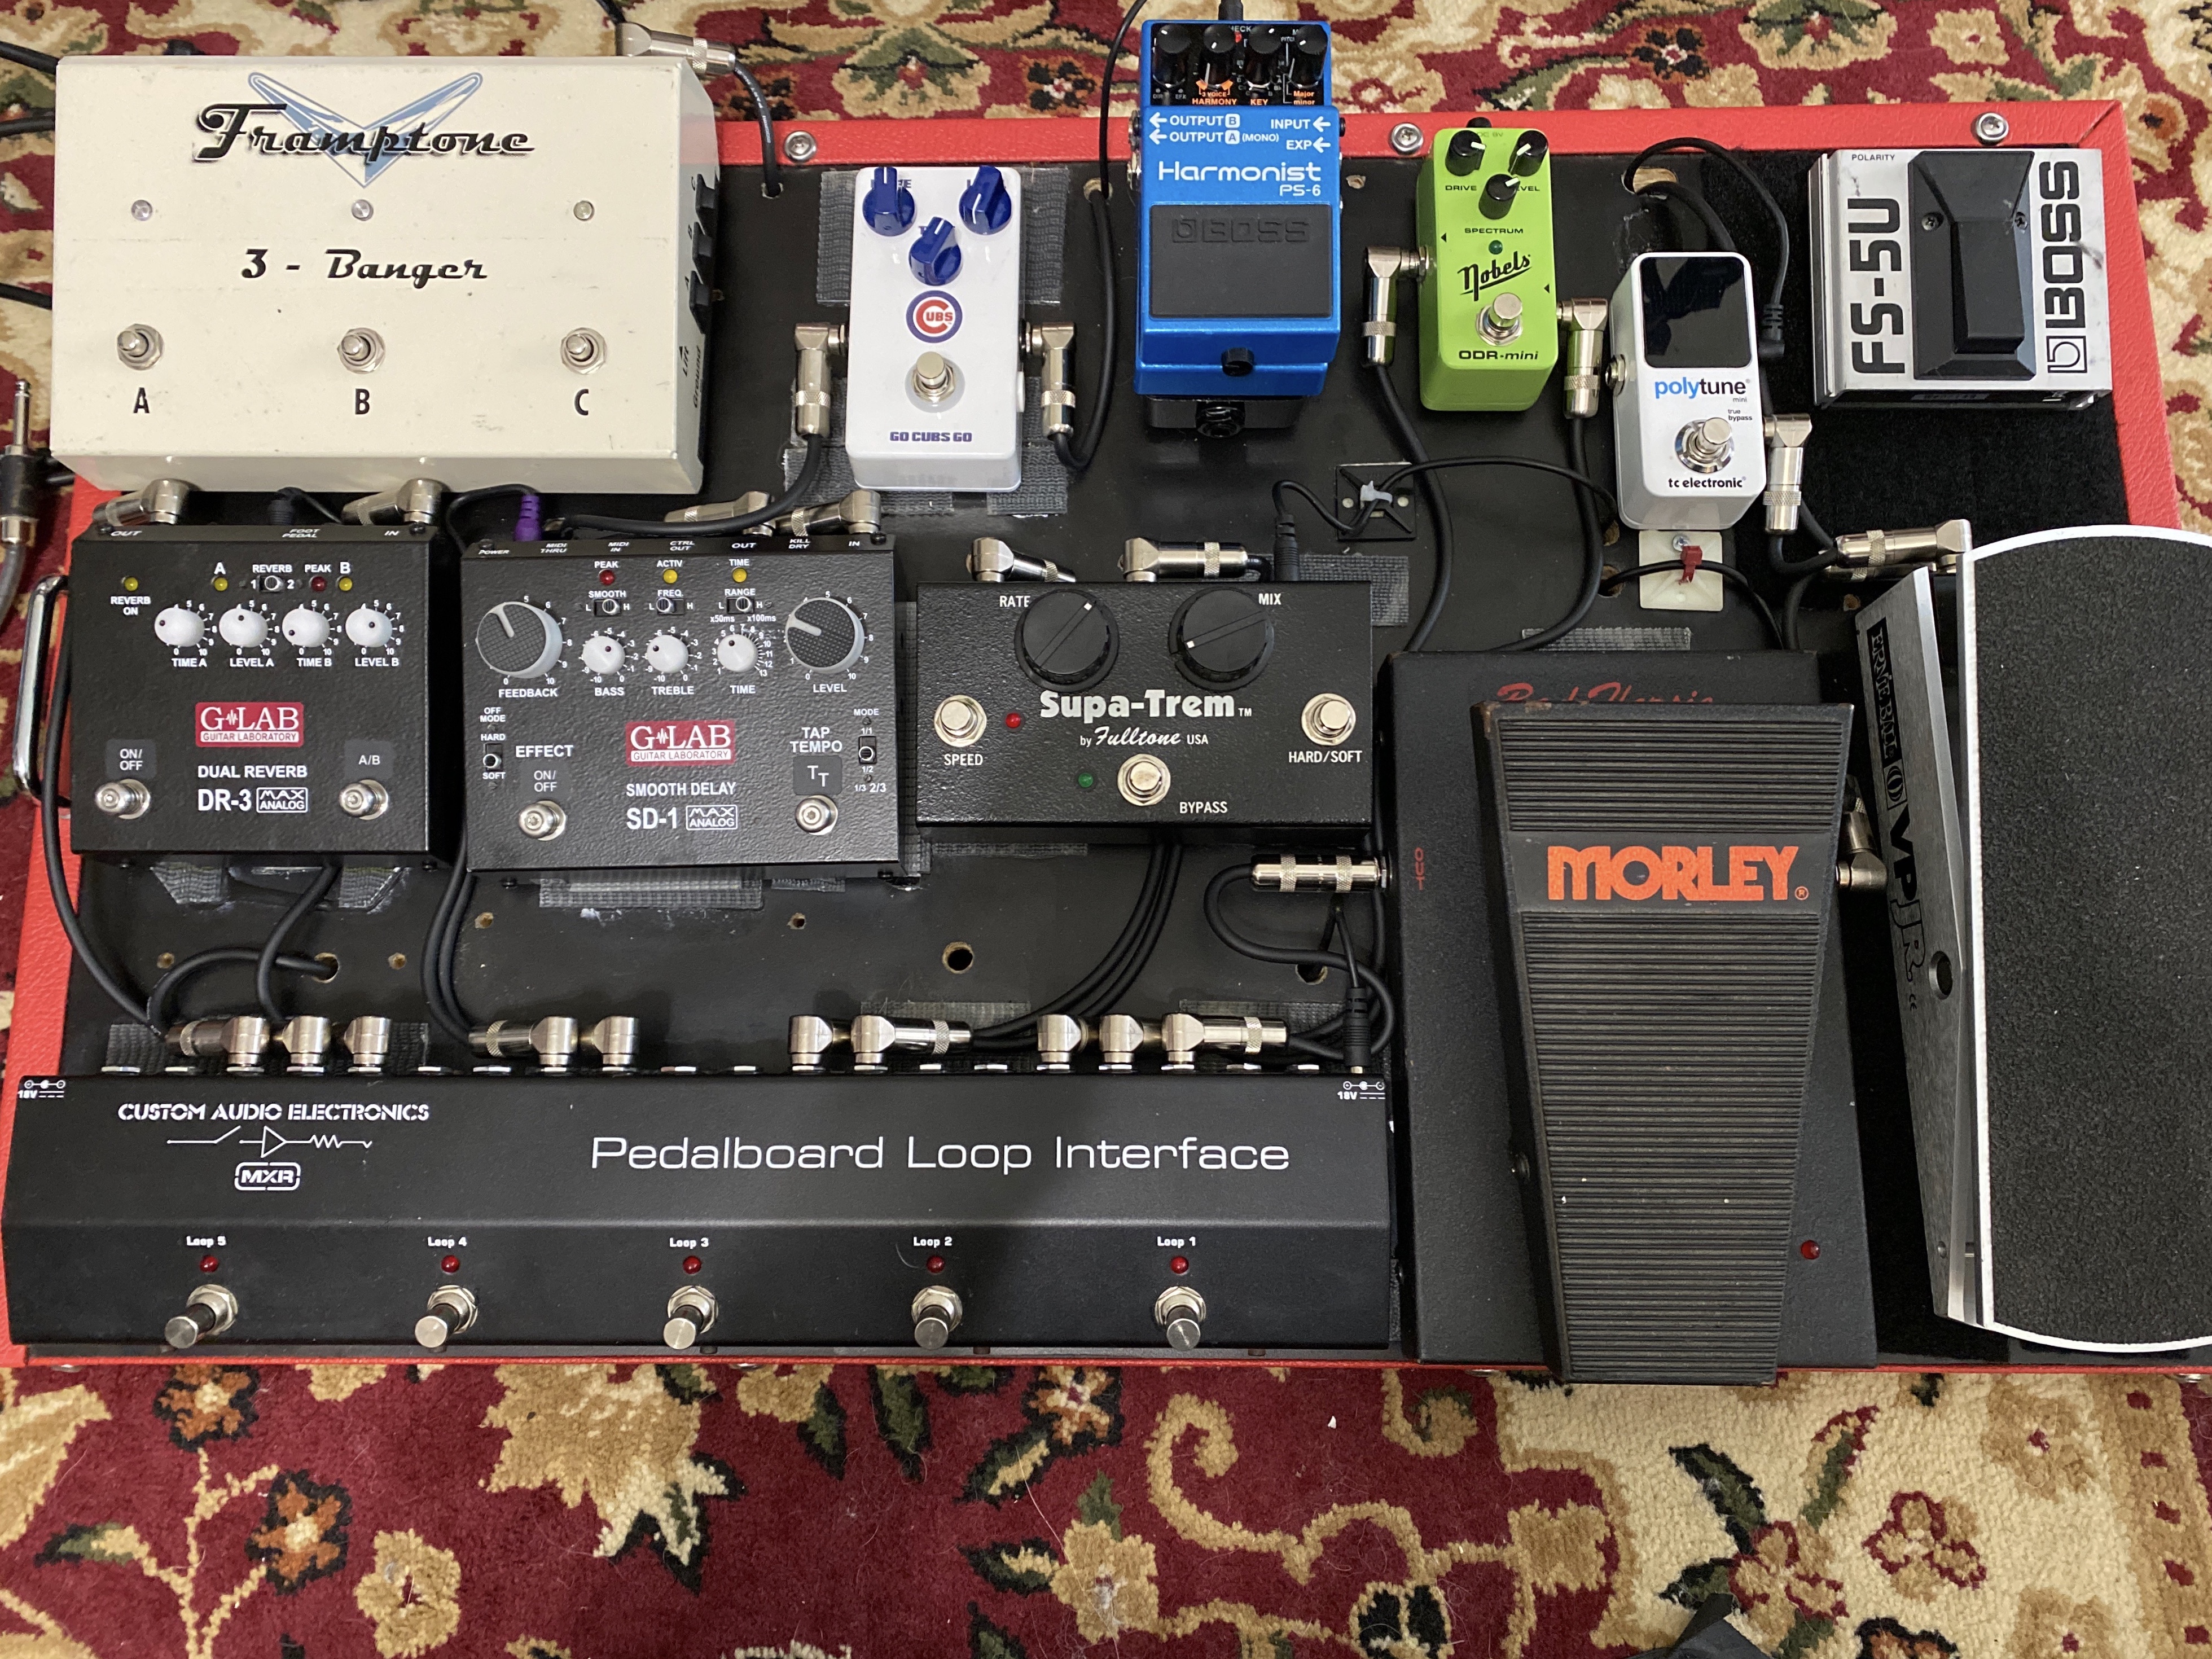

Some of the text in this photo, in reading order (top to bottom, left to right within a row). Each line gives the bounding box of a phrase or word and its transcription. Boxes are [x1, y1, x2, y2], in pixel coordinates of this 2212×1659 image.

[1170, 116, 1223, 126] OUTPUT
[1271, 119, 1310, 129] INPUT
[195, 103, 536, 163] Framptone
[1169, 132, 1223, 142] OUTPUT
[1242, 133, 1279, 142] (MONO)
[1286, 140, 1312, 150] EXP
[1158, 161, 1321, 181] Harmonist
[1279, 185, 1321, 196] PS-6
[2039, 161, 2086, 328] BOSS
[241, 248, 488, 288] 3 Banger
[1847, 198, 1905, 373] FS-5U
[916, 299, 953, 333] CUBS
[1654, 376, 1746, 399] polytune
[134, 388, 150, 414] A
[356, 389, 371, 415] B
[574, 389, 590, 415] C
[889, 431, 972, 442] GO CUBS GO
[1669, 477, 1743, 488] tc electronic
[214, 561, 226, 574] A
[252, 564, 292, 573] REVERB
[305, 564, 331, 573] PEAK
[340, 561, 350, 574] B
[111, 596, 151, 605] REVERB
[999, 595, 1030, 607] RATE
[1258, 593, 1281, 605] MIX
[123, 607, 138, 615] ON
[172, 658, 207, 667] TIME A
[230, 658, 274, 667] LEVEL A
[297, 658, 332, 667] TIME B
[355, 657, 400, 666] LEVEL B
[498, 688, 558, 697] FEEDBACK
[594, 687, 625, 696] BASS
[651, 686, 694, 695] TREBLE
[730, 685, 756, 694] TIME
[813, 684, 847, 692] LEVEL
[1040, 689, 1235, 724] Supa-Trem
[203, 732, 296, 741] GUITAR LABORATORY
[801, 727, 830, 739] TAP
[1080, 726, 1208, 748] by Fulltone USA
[515, 745, 574, 757] EFFECT
[789, 740, 842, 753] TEMPO
[120, 748, 142, 759] ON/
[633, 750, 728, 760] GUITAR LABORATORY
[1289, 750, 1362, 763] HARD/SOFT
[120, 760, 143, 771] OFF
[358, 755, 380, 765] A/B
[943, 754, 983, 766] SPEED
[198, 765, 308, 778] DUAL REVERB
[534, 770, 556, 780] ON/
[534, 782, 557, 792] OFF
[626, 782, 736, 797] SMOOTH DELAY
[870, 783, 886, 792] 2/3
[198, 788, 252, 811] DR-3
[259, 790, 304, 800] MAX
[260, 801, 305, 810] ANALOG
[1179, 801, 1228, 814] BYPASS
[689, 807, 734, 817] MAX
[626, 807, 677, 830] SD-1
[689, 818, 734, 827] ANALOG
[1415, 846, 1425, 890] OUT
[1547, 845, 1798, 901] MORLEY
[17, 1090, 38, 1099] 18V
[1337, 1091, 1357, 1100] 18V
[118, 1103, 429, 1121] CUSTOM AUDIO ELECTRONICS
[591, 1136, 1289, 1175] Pedalboard Loop Interface
[241, 1170, 294, 1183] MXR
[187, 1236, 226, 1248] Loop 5
[428, 1236, 467, 1248] Loop 4
[669, 1237, 709, 1249] Loop 3
[913, 1236, 952, 1248] Loop 2
[1157, 1236, 1196, 1248] Loop 1
